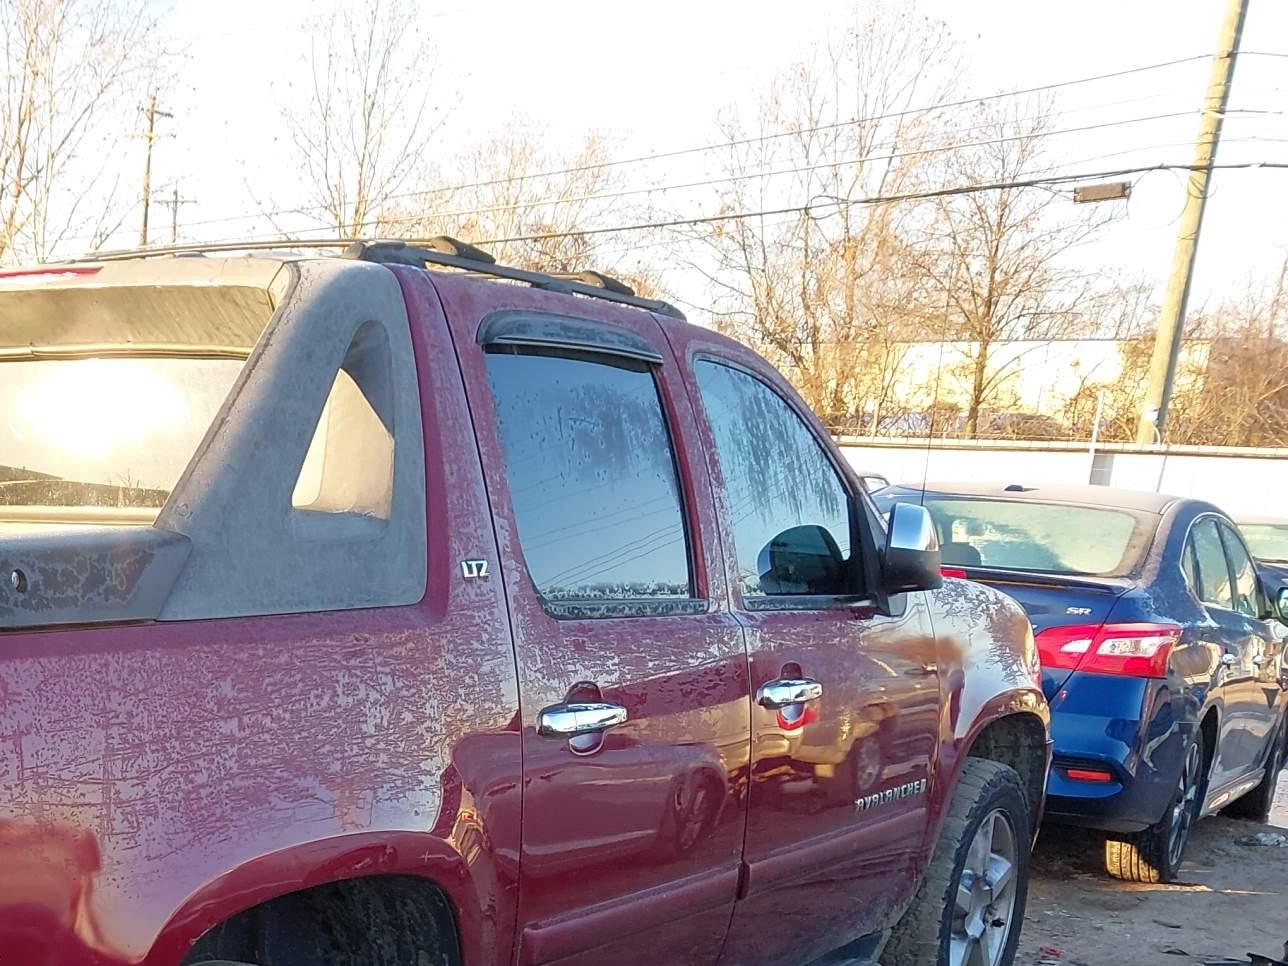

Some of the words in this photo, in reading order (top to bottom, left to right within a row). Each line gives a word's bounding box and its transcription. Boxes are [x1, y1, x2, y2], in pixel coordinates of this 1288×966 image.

[461, 560, 489, 578] LTZ
[1065, 606, 1092, 616] SR
[854, 779, 924, 810] AVALANCHE
